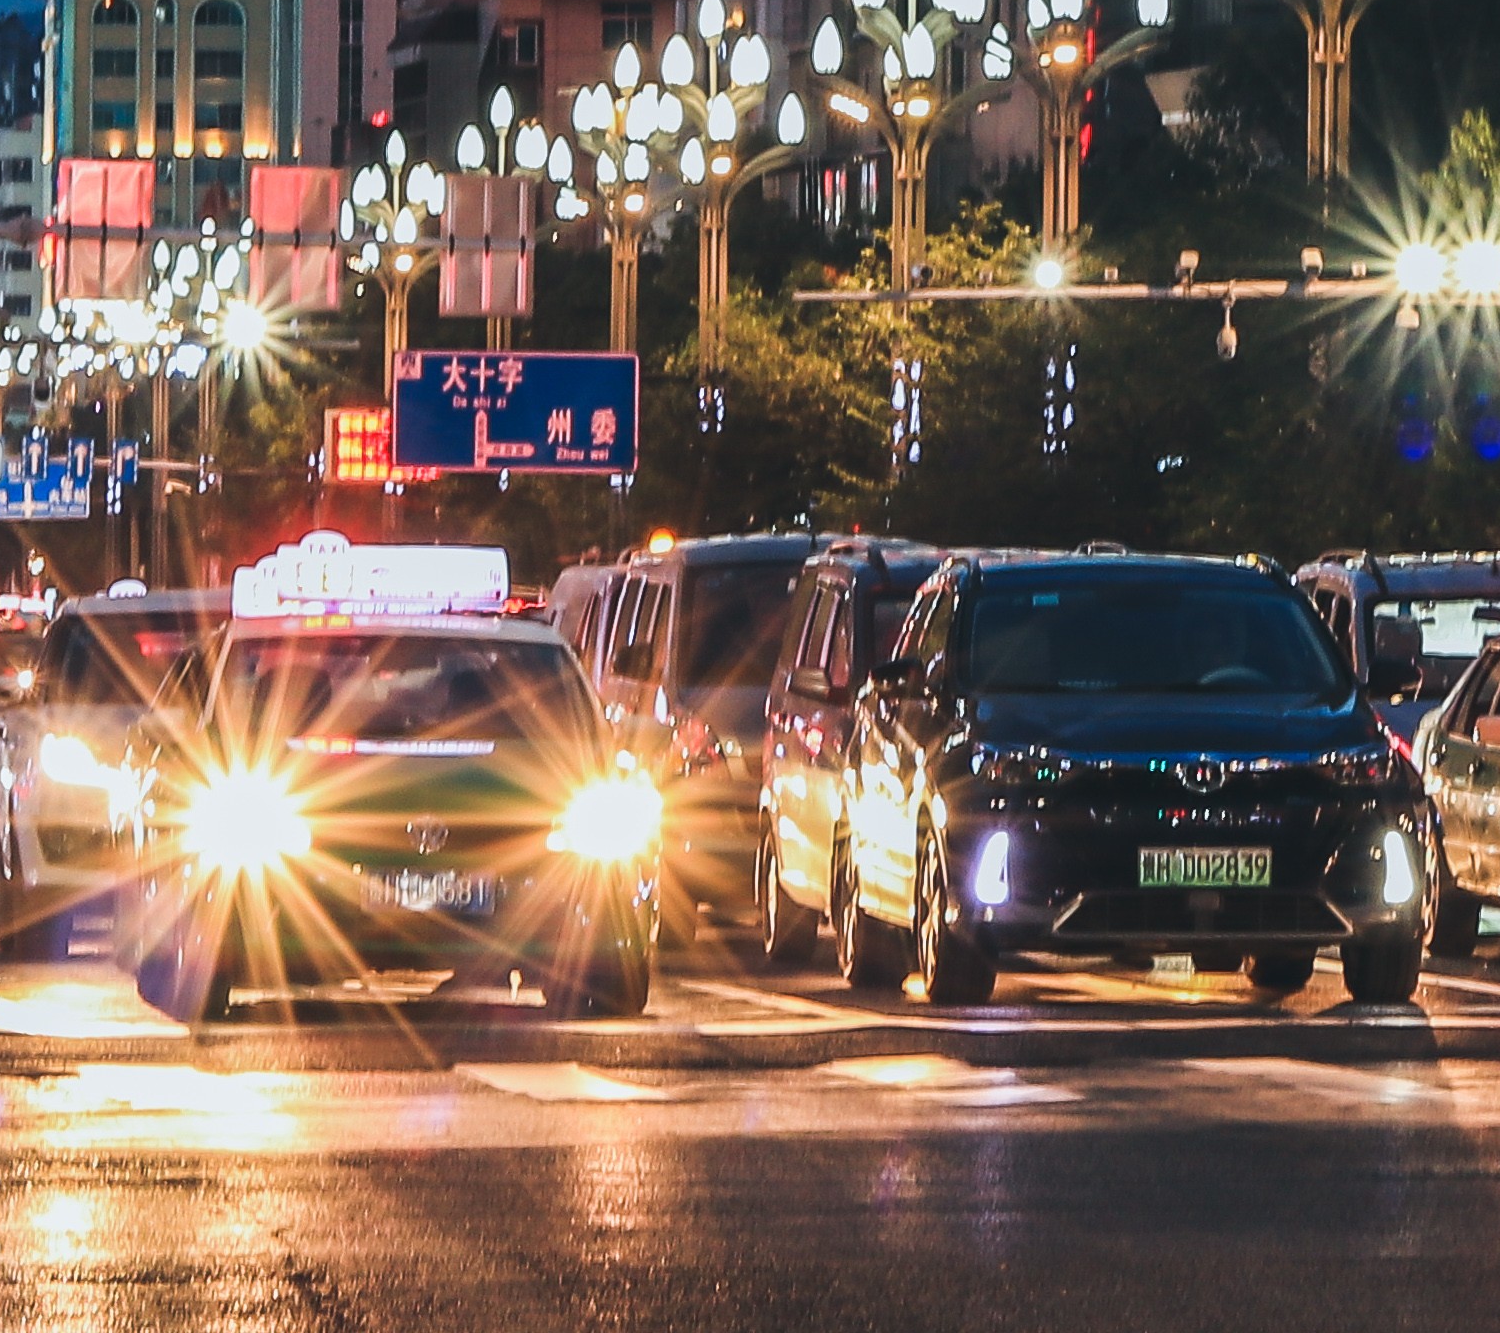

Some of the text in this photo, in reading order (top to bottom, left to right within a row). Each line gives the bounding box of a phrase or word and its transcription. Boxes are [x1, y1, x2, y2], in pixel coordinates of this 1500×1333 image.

[442, 356, 524, 394] 大十字
[309, 544, 346, 554] TAXI
